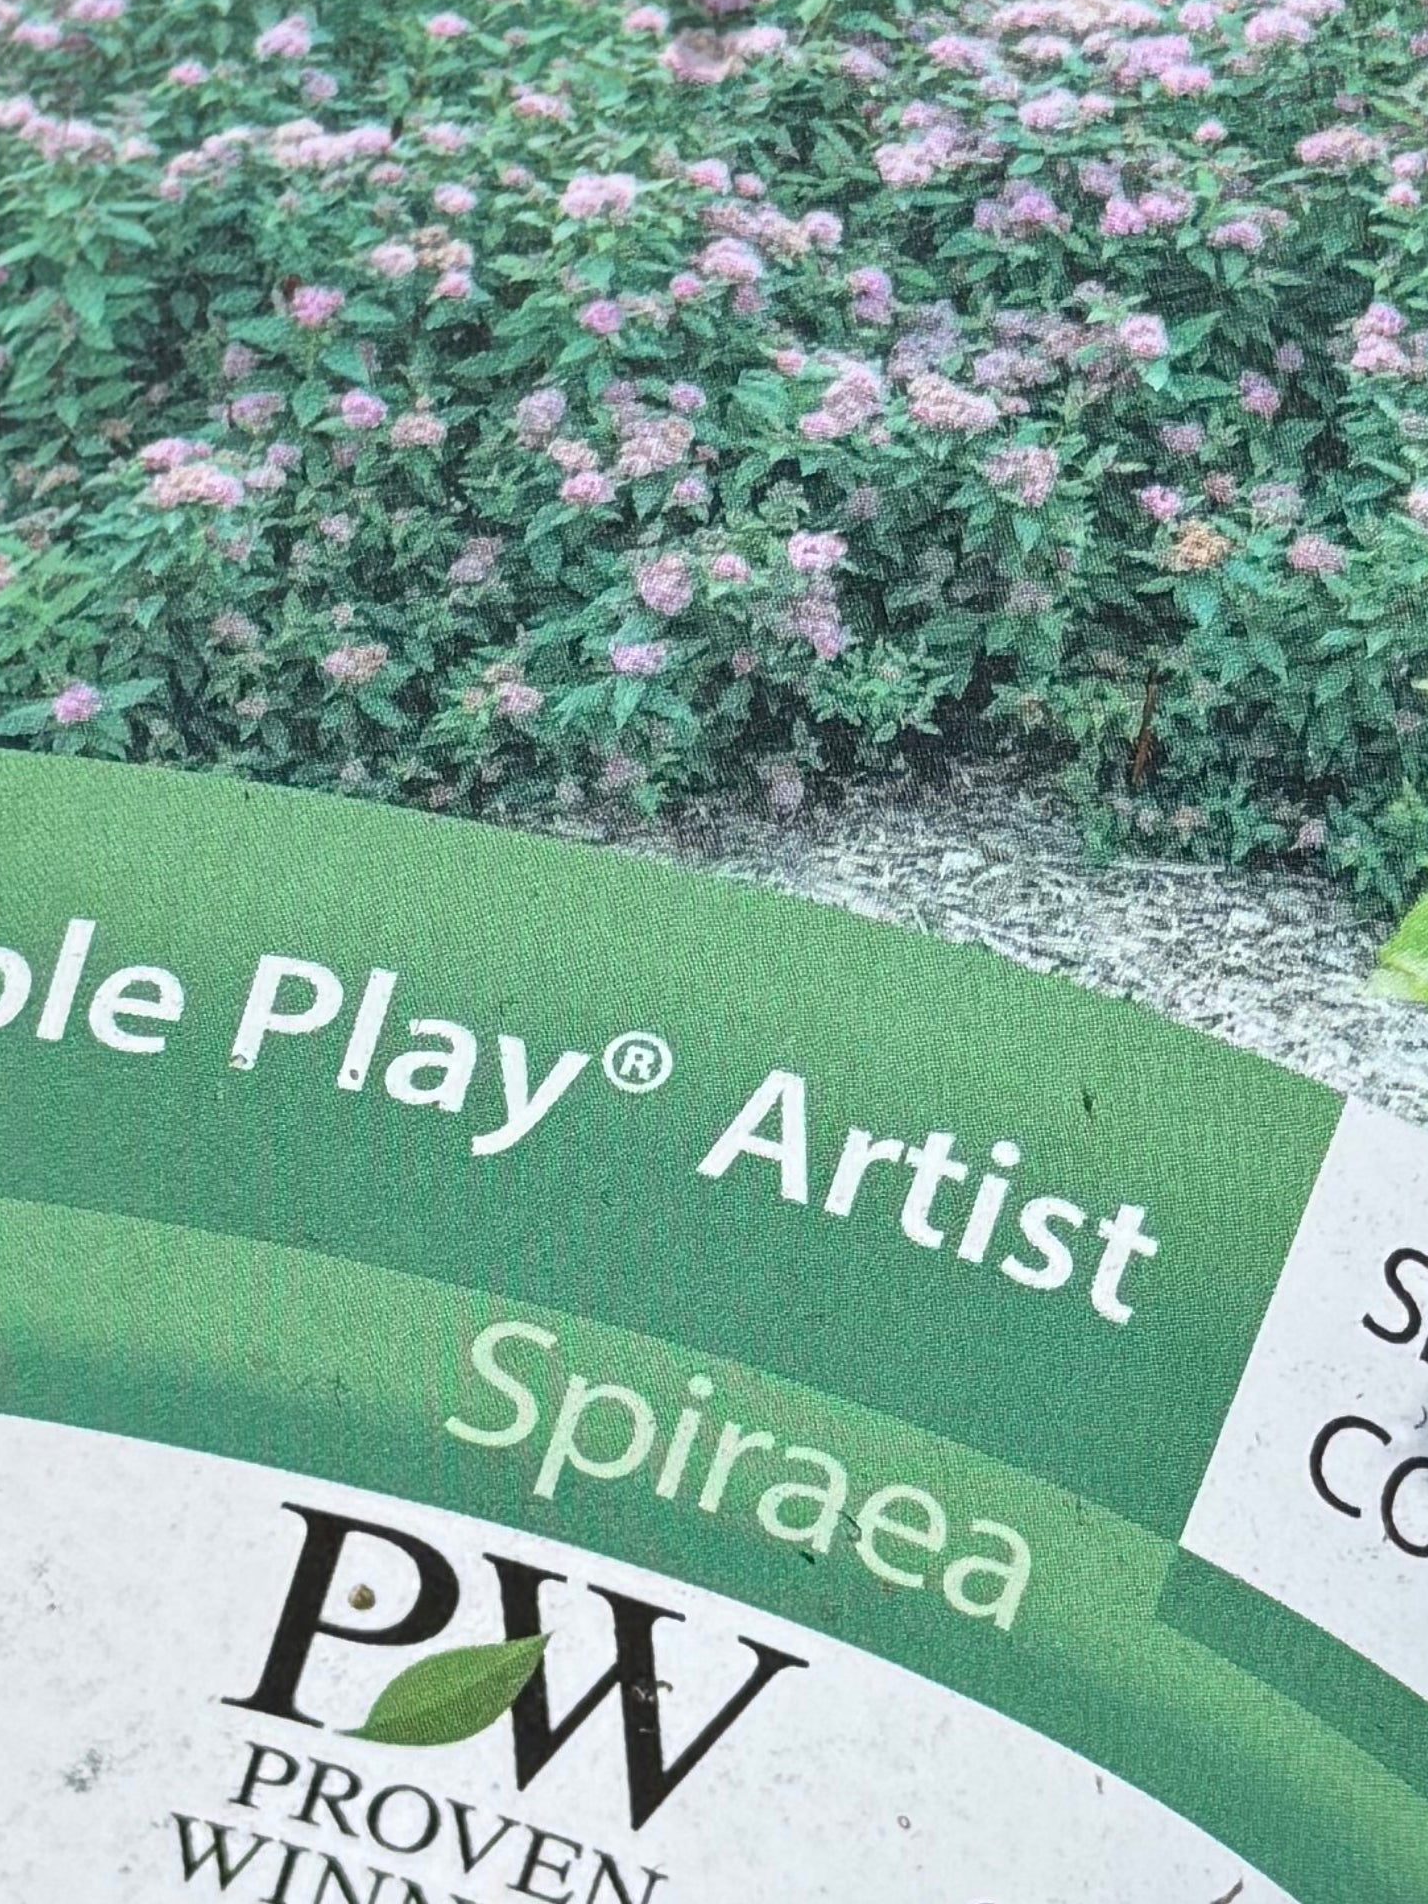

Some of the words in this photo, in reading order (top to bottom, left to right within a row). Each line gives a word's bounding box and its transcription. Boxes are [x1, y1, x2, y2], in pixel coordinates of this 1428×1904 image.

[697, 1068, 1162, 1327] Artist
[444, 1316, 1034, 1631] Spiraea
[221, 1500, 810, 1832] PW
